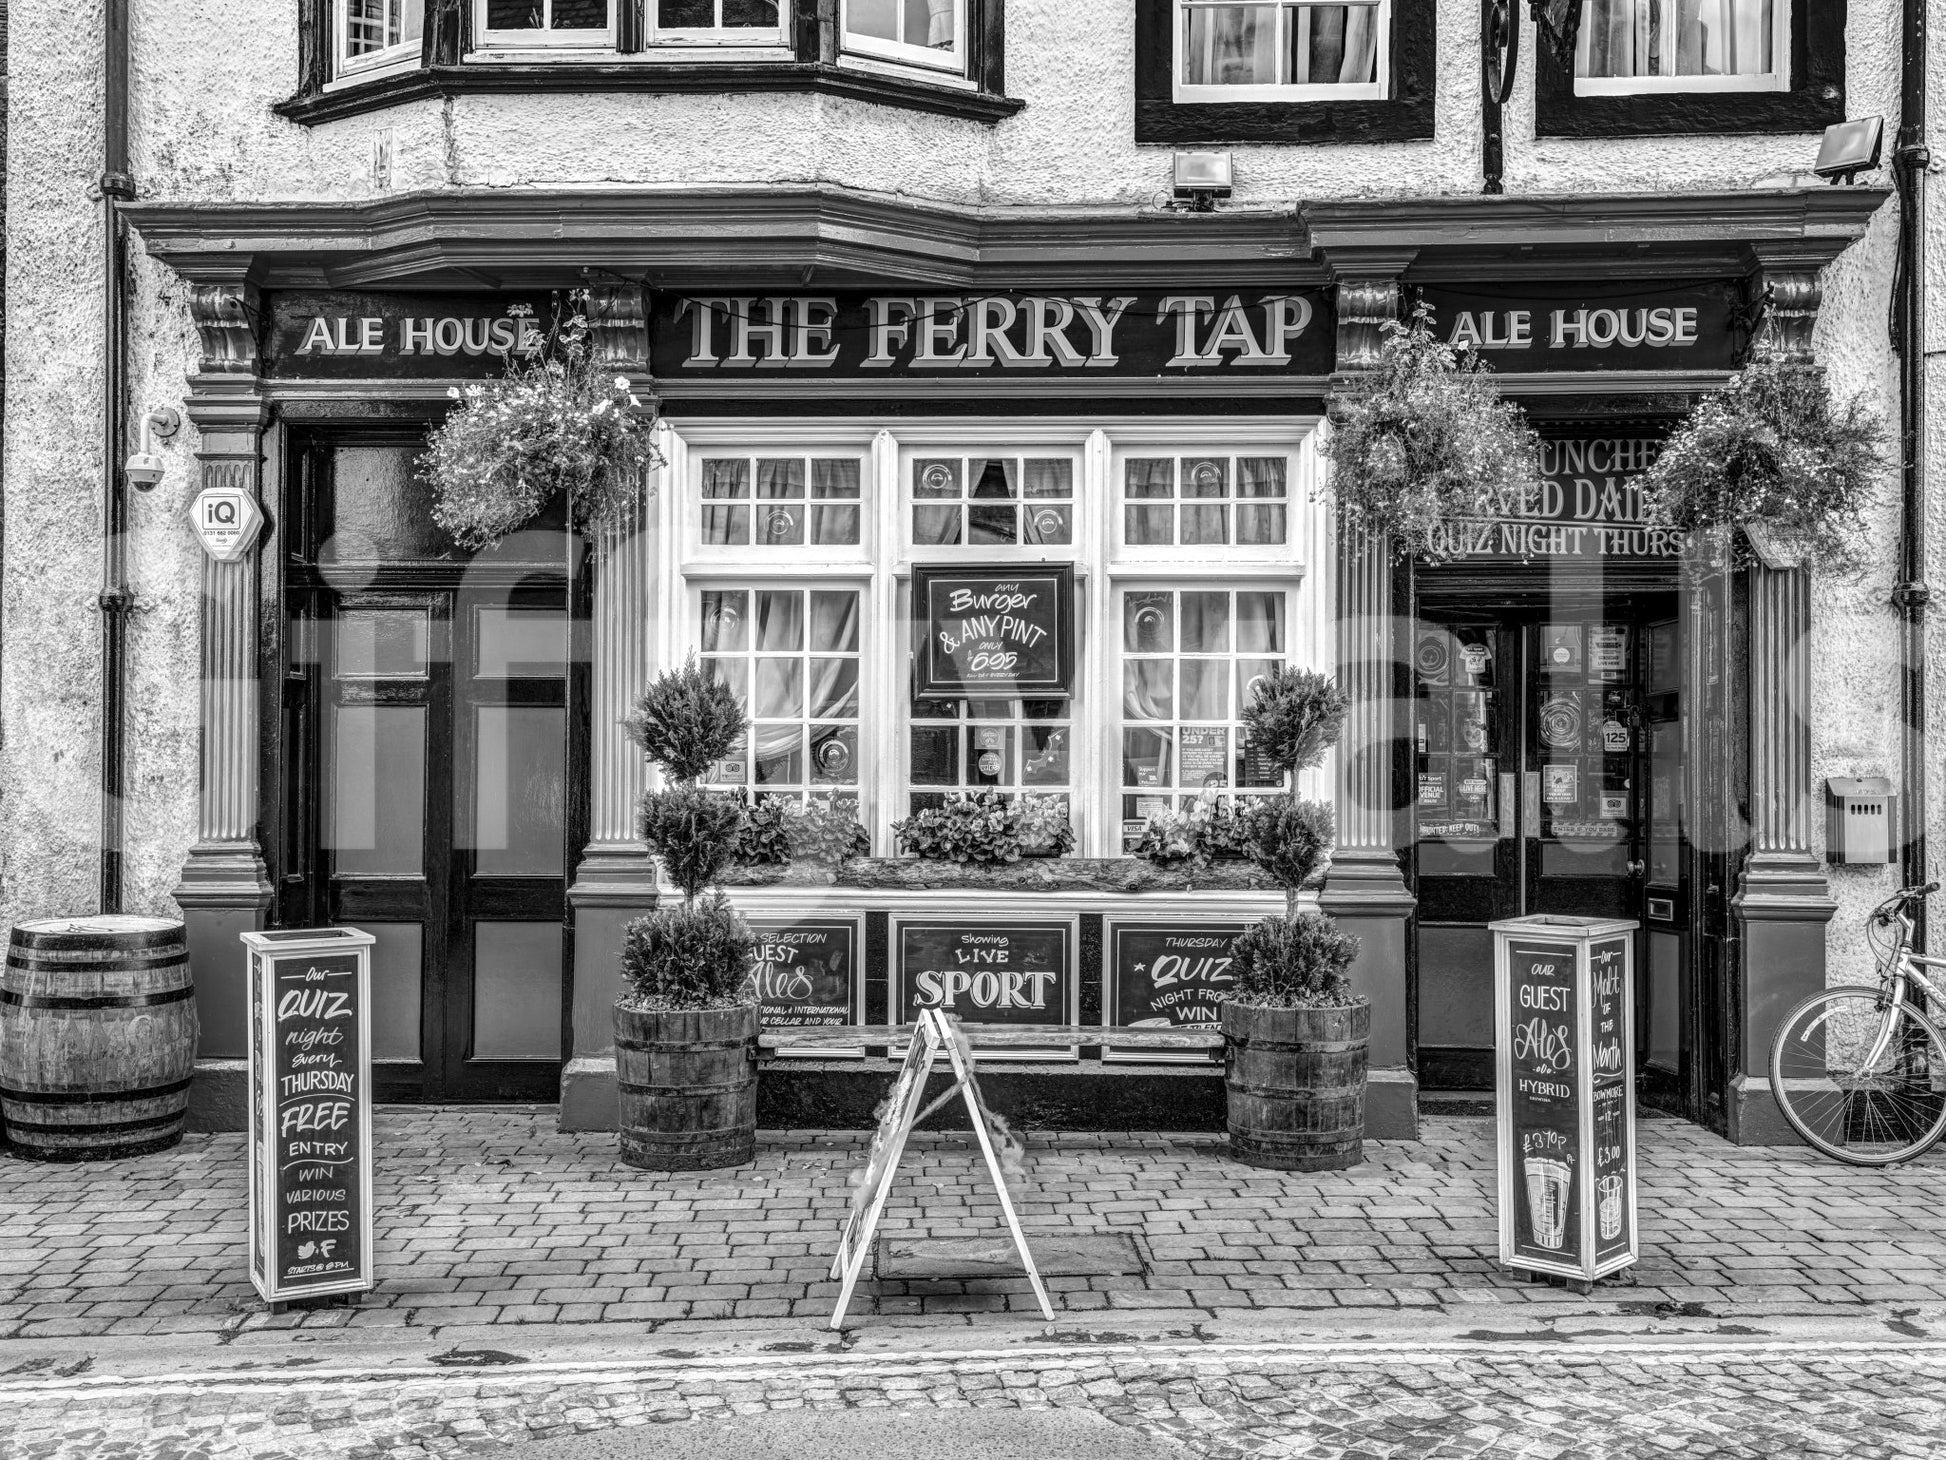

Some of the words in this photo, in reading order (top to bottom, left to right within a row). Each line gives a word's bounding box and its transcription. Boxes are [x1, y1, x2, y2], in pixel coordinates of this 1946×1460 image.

[296, 317, 385, 355] ALE
[400, 317, 540, 355] HOUSE
[676, 296, 840, 368] THE
[860, 296, 1136, 368] FERRY
[1157, 294, 1312, 367] TAP
[1449, 309, 1532, 348] ALE
[1550, 307, 1698, 348] HOUSE
[1539, 438, 1663, 476] UNCHE
[1574, 477, 1656, 522] DAIL
[207, 501, 235, 524] iQ
[1427, 521, 1495, 559] QUIZ
[1501, 524, 1587, 555] NIGHT
[1593, 527, 1686, 558] THURS
[995, 584, 1019, 593] any
[950, 588, 1038, 614] Burger
[939, 631, 961, 654] &
[961, 615, 1000, 643] ANY
[1000, 615, 1048, 648] PINT
[978, 642, 1003, 650] ONLY
[1182, 727, 1226, 736] UNDER
[1605, 732, 1626, 743] 125
[760, 932, 828, 944] SELECTION
[961, 933, 1009, 947] Showing
[1165, 937, 1228, 948] THURSDAY
[748, 944, 799, 964] UEST
[955, 949, 1009, 964] LIVE
[305, 966, 330, 981] Our
[738, 961, 814, 1000] Ales
[1151, 954, 1234, 989] QUIZ
[1531, 963, 1555, 976] OUR
[913, 971, 1056, 1010] SPORT
[1519, 984, 1571, 1012] GUEST
[1592, 965, 1620, 1009] Malt
[277, 988, 353, 1022] QUIZ
[1150, 988, 1194, 1012] NIGHT
[1198, 988, 1223, 1004] FRO
[1602, 1002, 1612, 1015] OF
[770, 1016, 802, 1026] CELLAR
[804, 1017, 821, 1025] AND
[1175, 1006, 1217, 1021] WIN
[1600, 1019, 1614, 1033] THE
[286, 1026, 344, 1051] night
[1592, 1036, 1622, 1071] Month
[280, 1070, 354, 1097] THURSDAY
[1519, 1079, 1571, 1098] HYBRID
[1592, 1084, 1624, 1102] BOWMORE
[281, 1101, 351, 1138] FREE
[289, 1141, 348, 1157] ENTRY
[299, 1165, 334, 1182] WIN
[286, 1188, 346, 1204] VARIOUS
[287, 1210, 350, 1234] PRIZES
